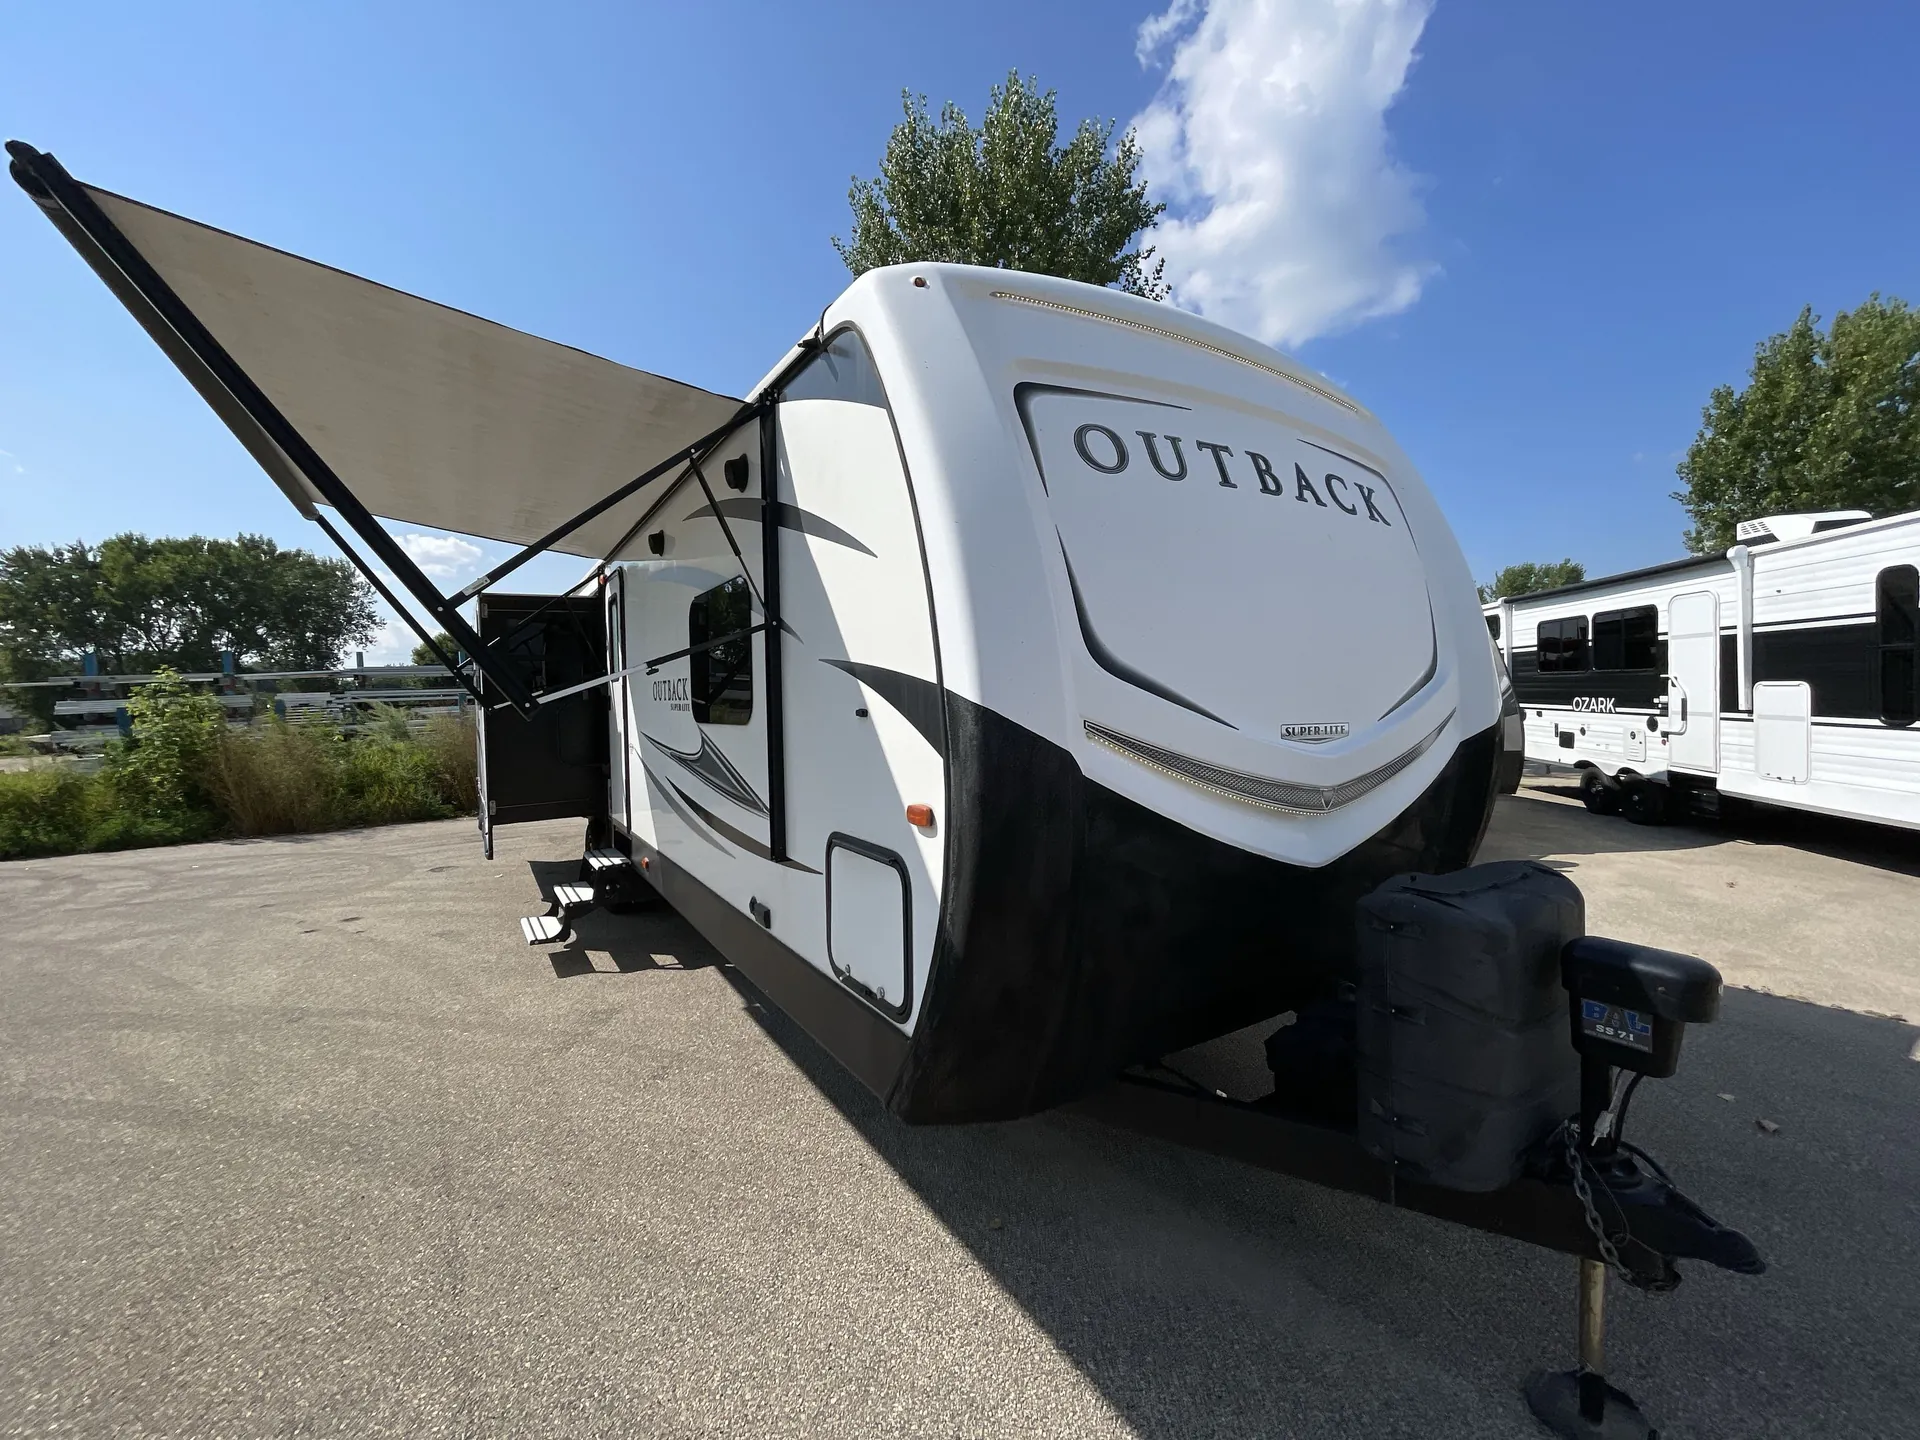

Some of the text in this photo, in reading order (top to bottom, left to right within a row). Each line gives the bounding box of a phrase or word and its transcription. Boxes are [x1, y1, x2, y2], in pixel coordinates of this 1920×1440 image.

[1073, 423, 1391, 527] OUTBACK
[652, 677, 689, 701] OUTBACK
[1572, 696, 1616, 714] OZARK
[1284, 724, 1346, 737] SUPER-LITE
[1581, 998, 1651, 1036] BAL
[1595, 1024, 1614, 1036] SS
